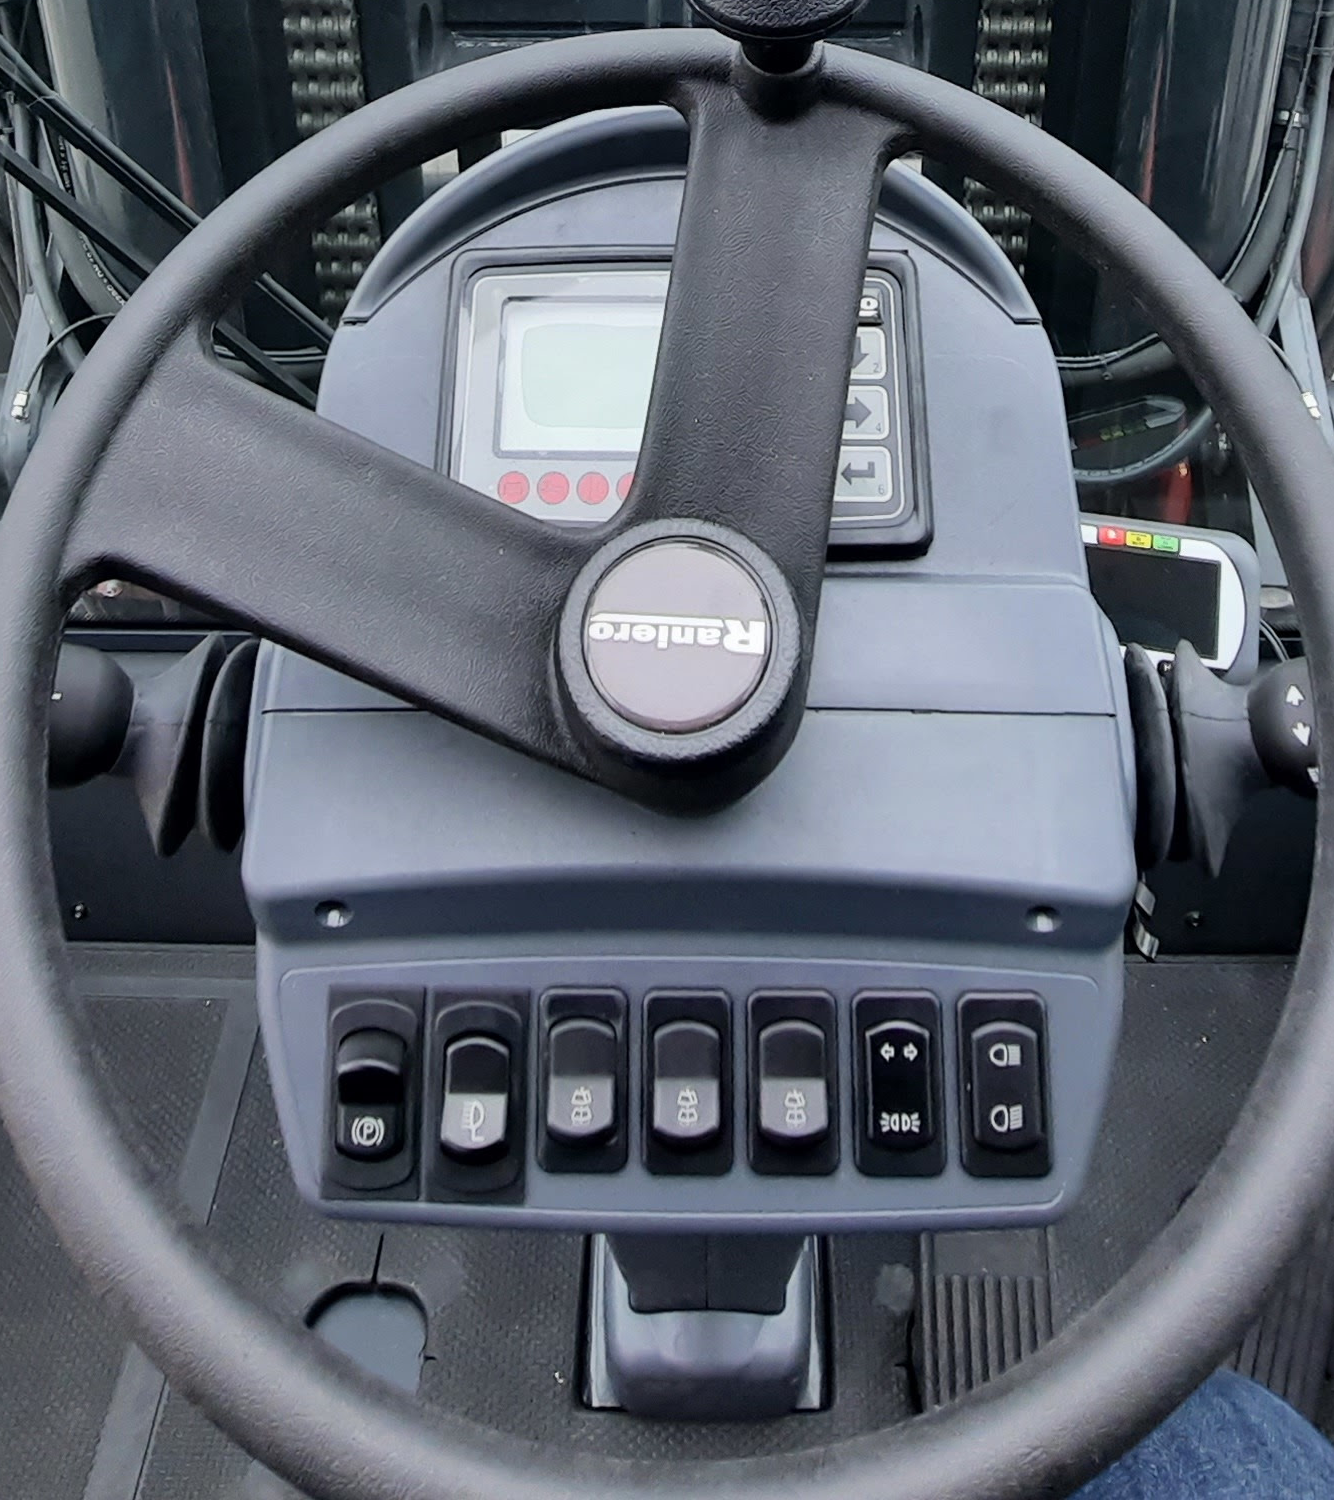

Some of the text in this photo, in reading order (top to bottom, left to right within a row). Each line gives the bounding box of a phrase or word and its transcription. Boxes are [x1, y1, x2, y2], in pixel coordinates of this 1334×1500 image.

[872, 362, 880, 373] 2
[875, 422, 882, 432] 4
[877, 484, 885, 495] 6
[588, 613, 766, 655] Raniero
